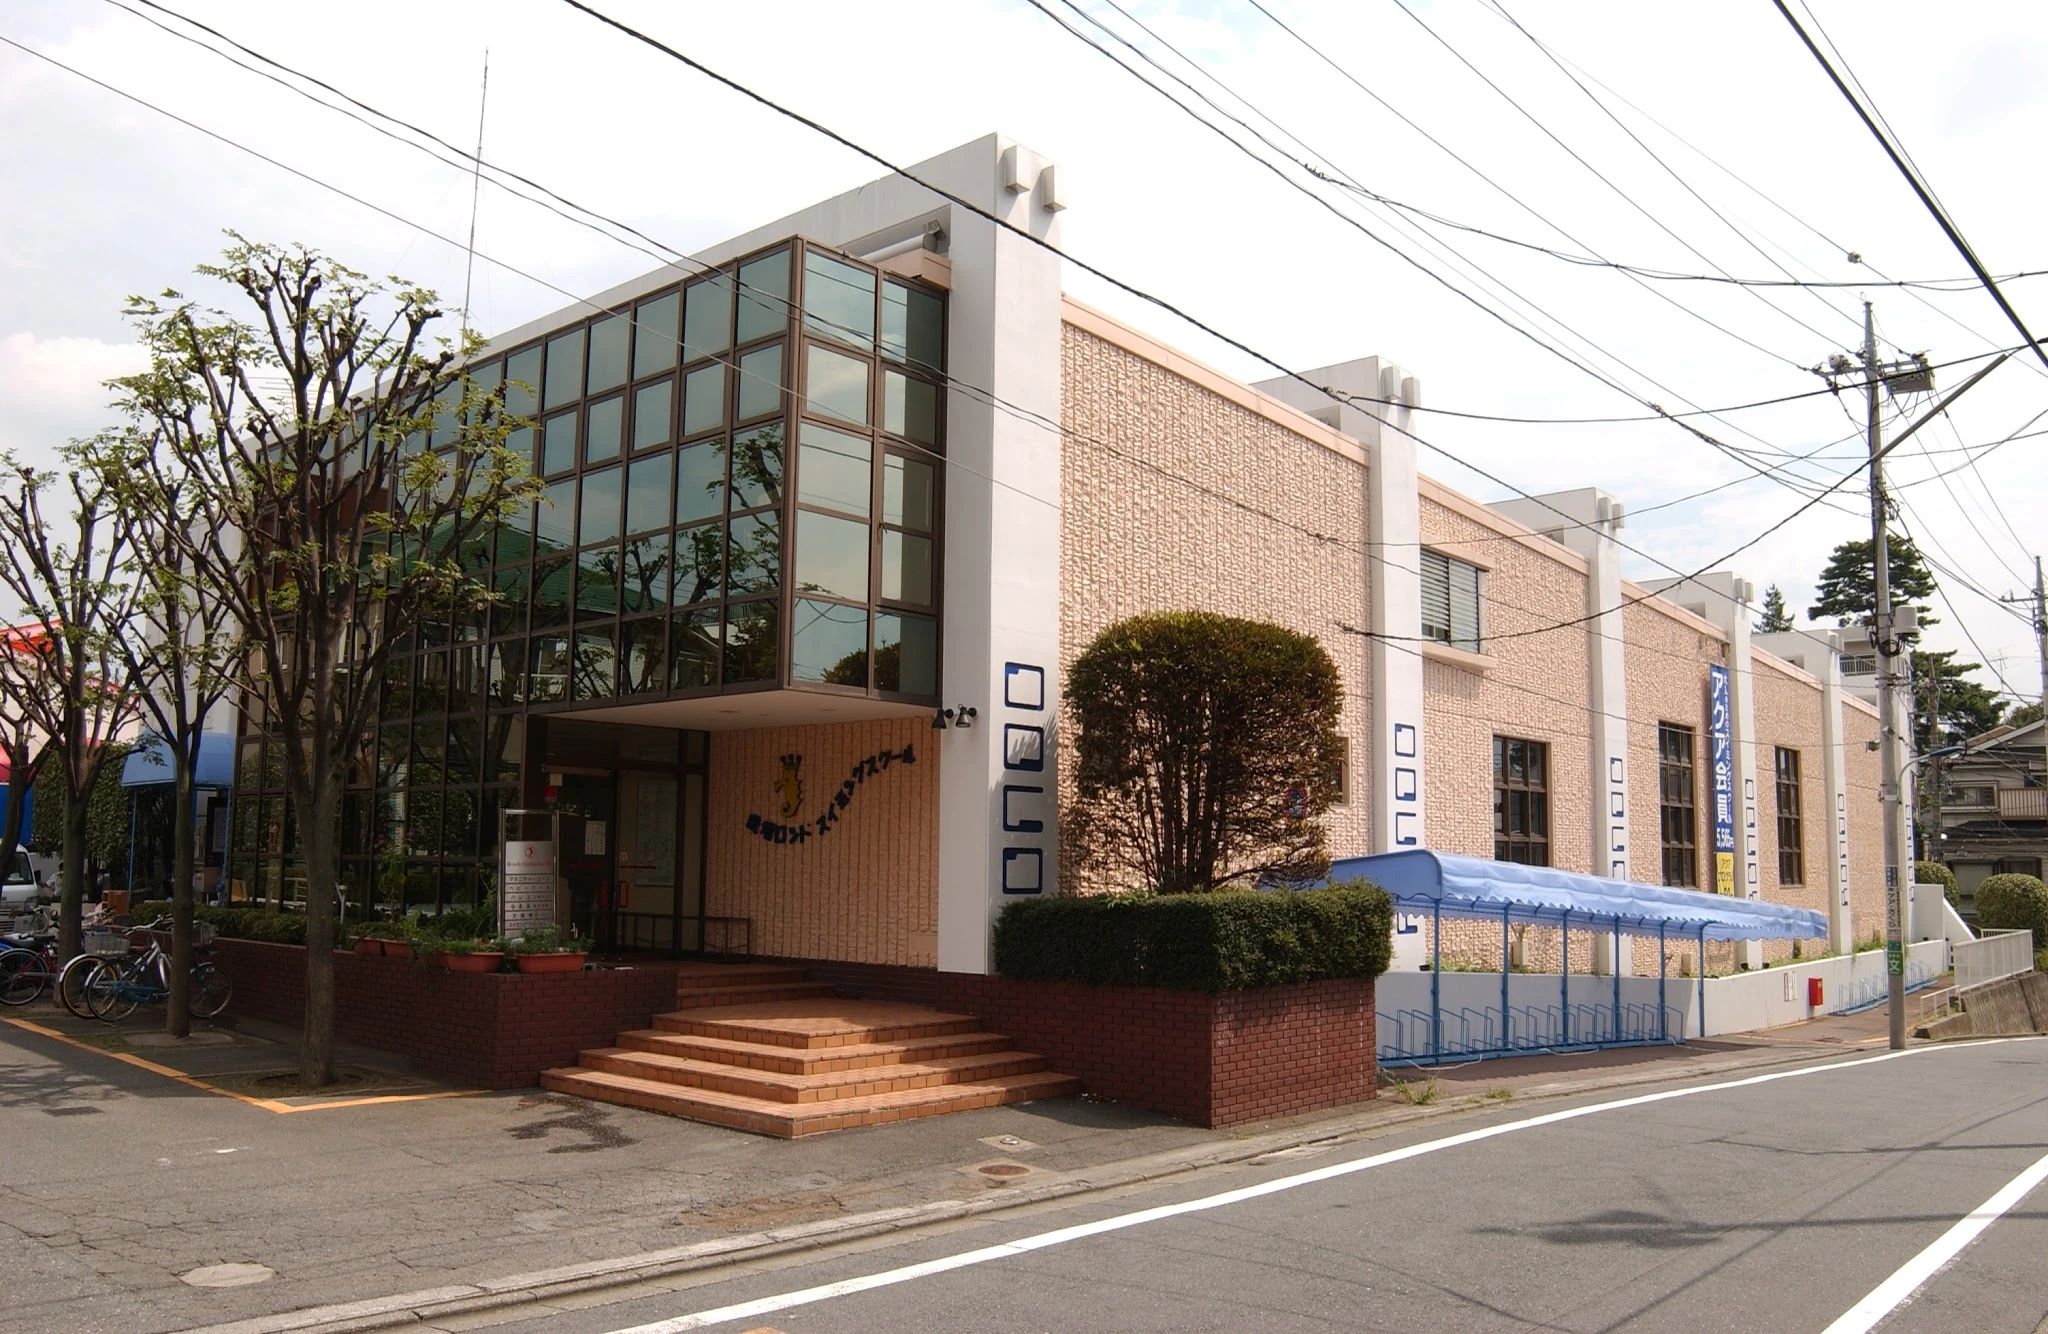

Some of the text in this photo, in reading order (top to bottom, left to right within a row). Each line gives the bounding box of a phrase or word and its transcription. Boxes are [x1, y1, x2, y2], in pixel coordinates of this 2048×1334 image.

[1712, 671, 1729, 823] アクア会員
[1889, 959, 1900, 971] 文
